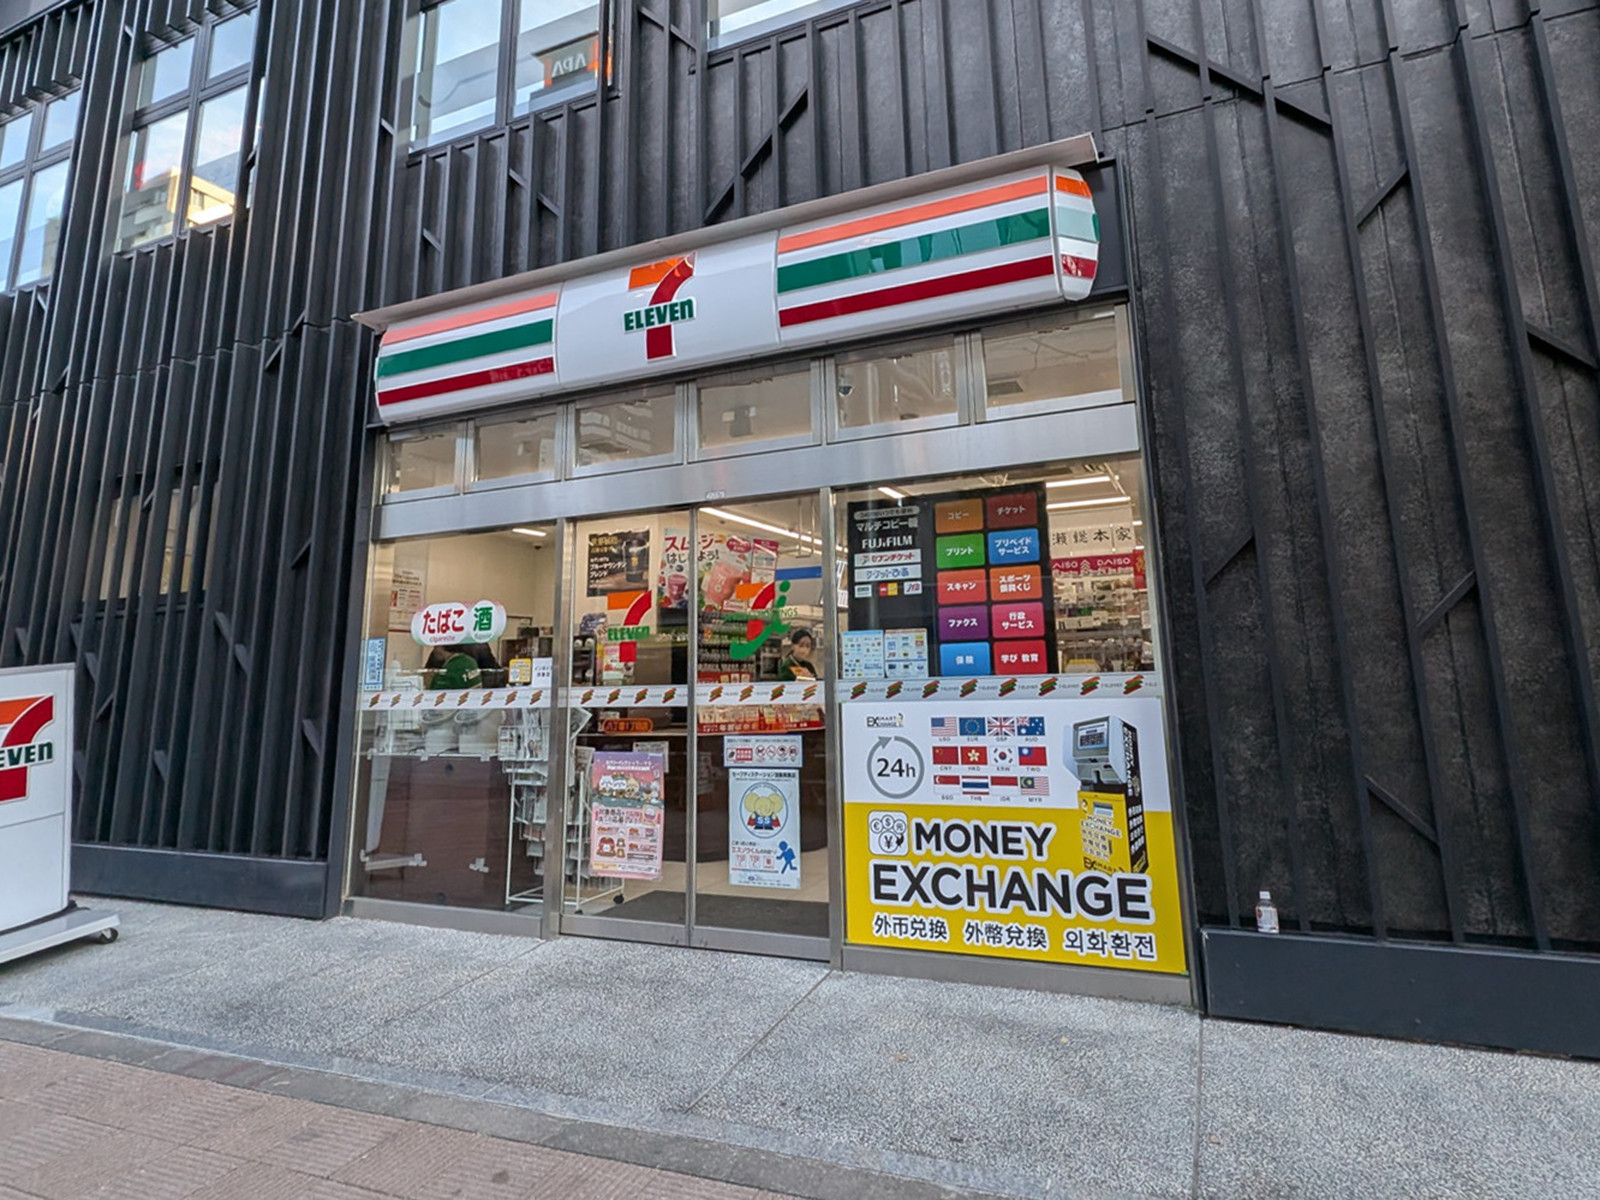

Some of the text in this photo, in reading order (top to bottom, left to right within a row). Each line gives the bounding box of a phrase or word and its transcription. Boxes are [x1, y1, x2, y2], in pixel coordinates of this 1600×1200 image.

[948, 511, 969, 520] コピー
[997, 506, 1026, 515] チケット
[946, 546, 974, 556] プリント
[998, 547, 1029, 556] サービス
[947, 582, 976, 591] スキャン
[422, 609, 464, 635] たばこ
[473, 607, 493, 631] 酒
[948, 618, 978, 627] ファクス
[1002, 620, 1034, 630] サービス
[877, 758, 916, 777] 24h
[915, 822, 1052, 857] MONEY
[873, 864, 1150, 919] EXCHANGE
[874, 914, 1155, 959] 外币兑换 外幣兌換 외화환전
